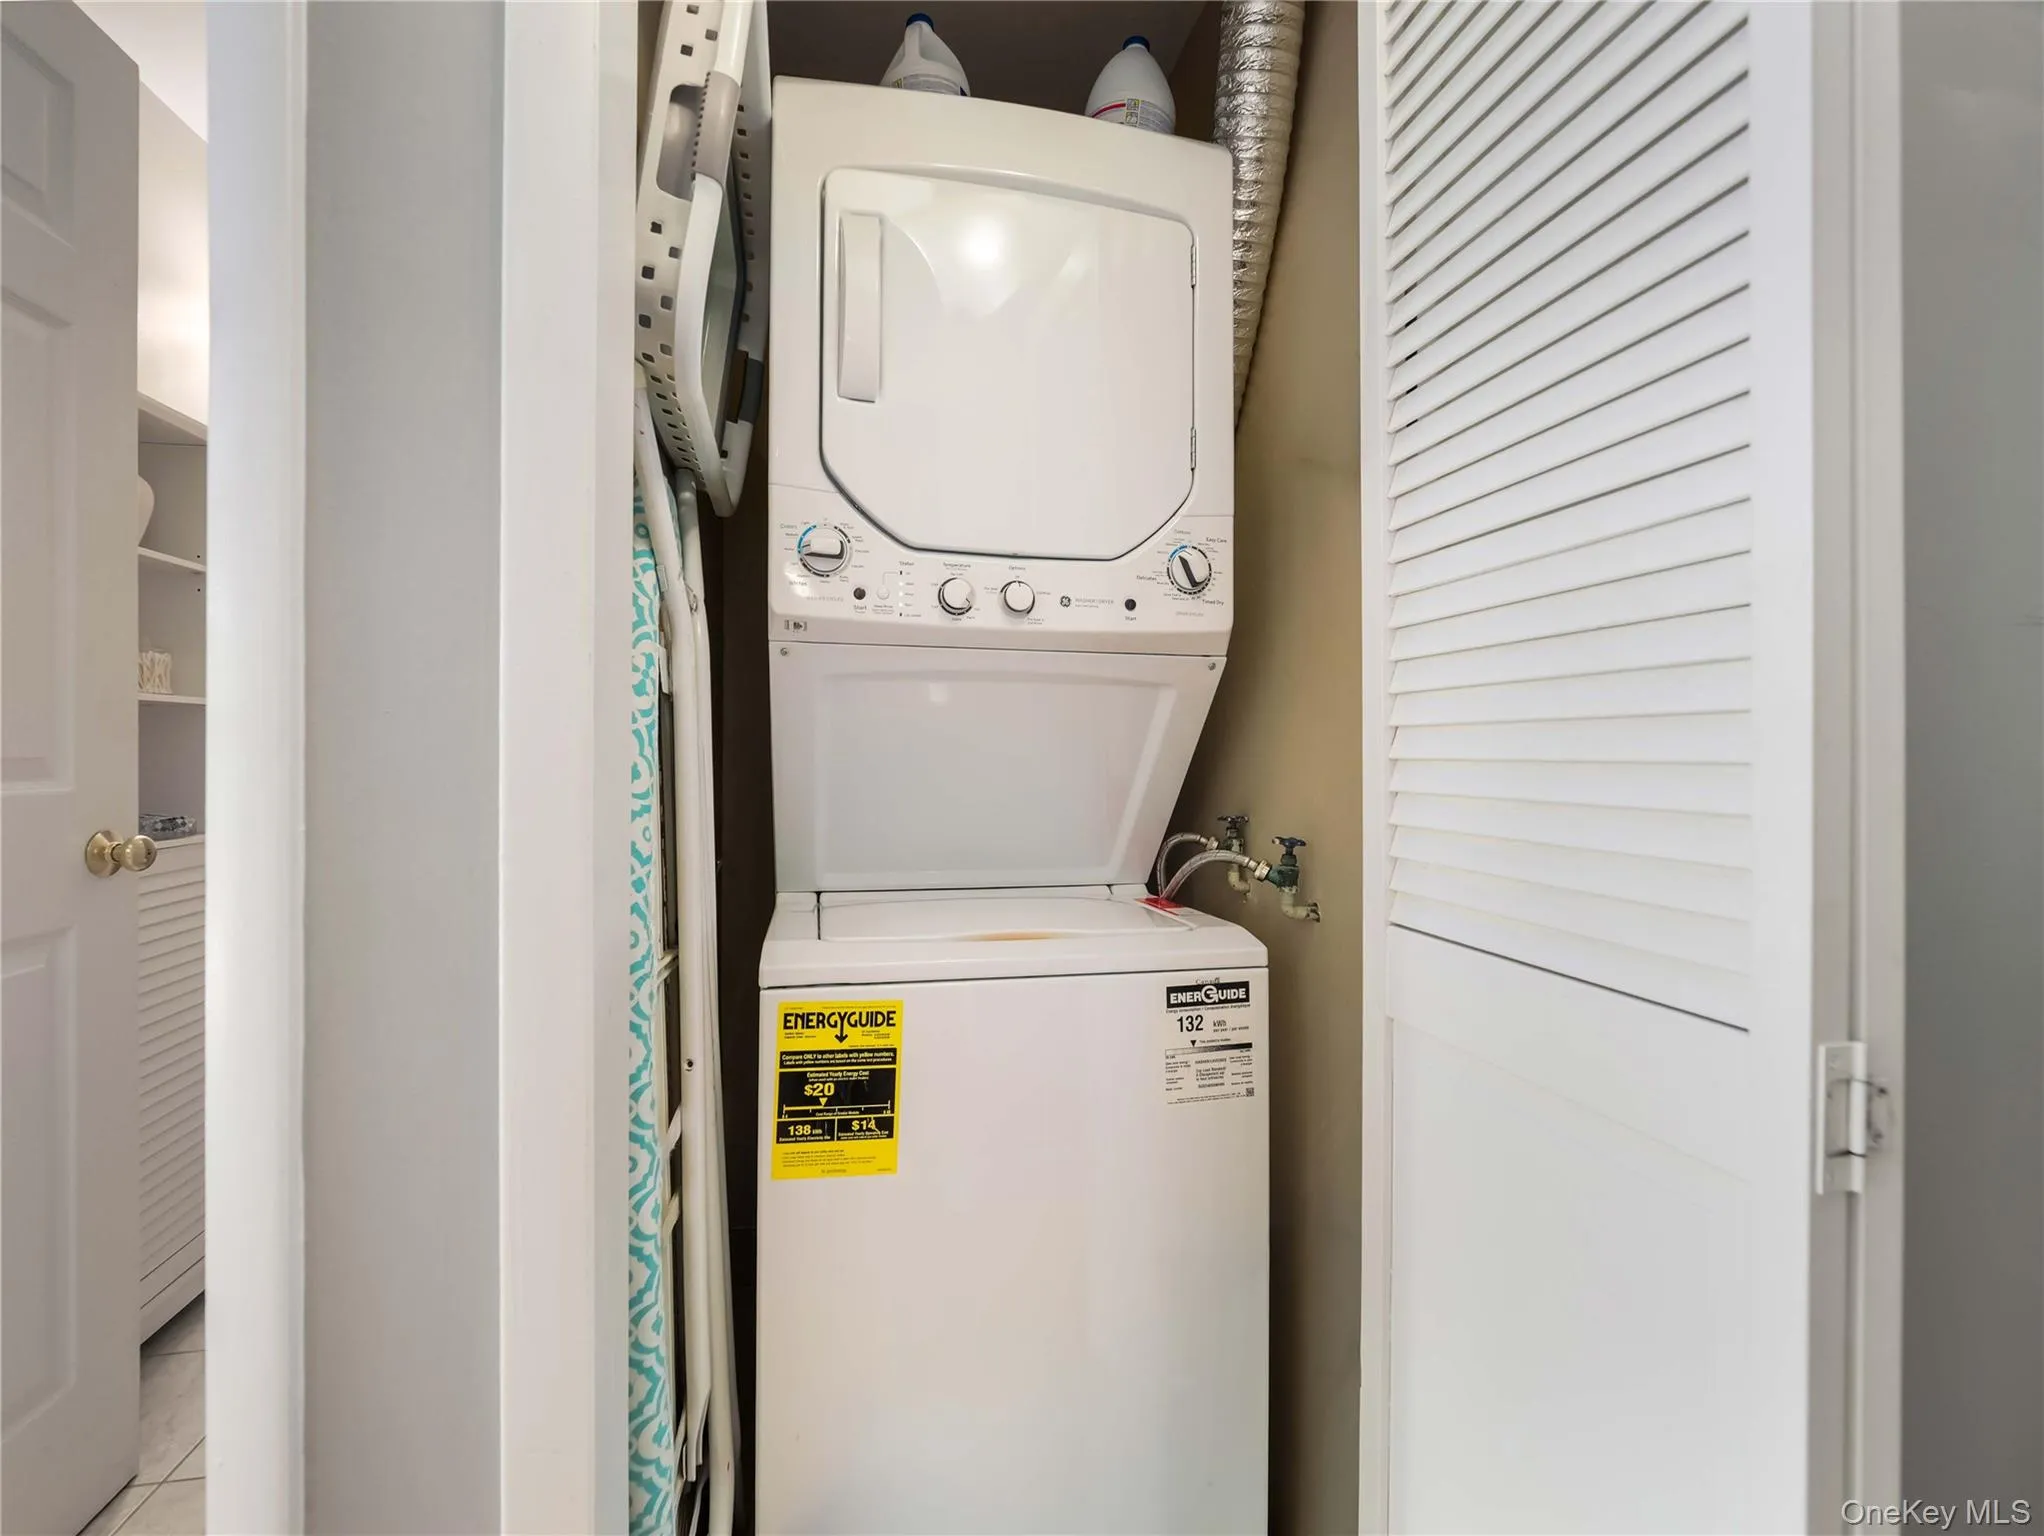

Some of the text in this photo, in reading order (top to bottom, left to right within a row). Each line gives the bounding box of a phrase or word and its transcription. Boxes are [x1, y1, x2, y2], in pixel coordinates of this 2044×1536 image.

[1170, 985, 1247, 1004] ENERGUIDE
[783, 1010, 896, 1030] ENERGYGUIDE
[1177, 1014, 1204, 1032] 132
[804, 1082, 835, 1096] $20
[788, 1125, 812, 1136] 138
